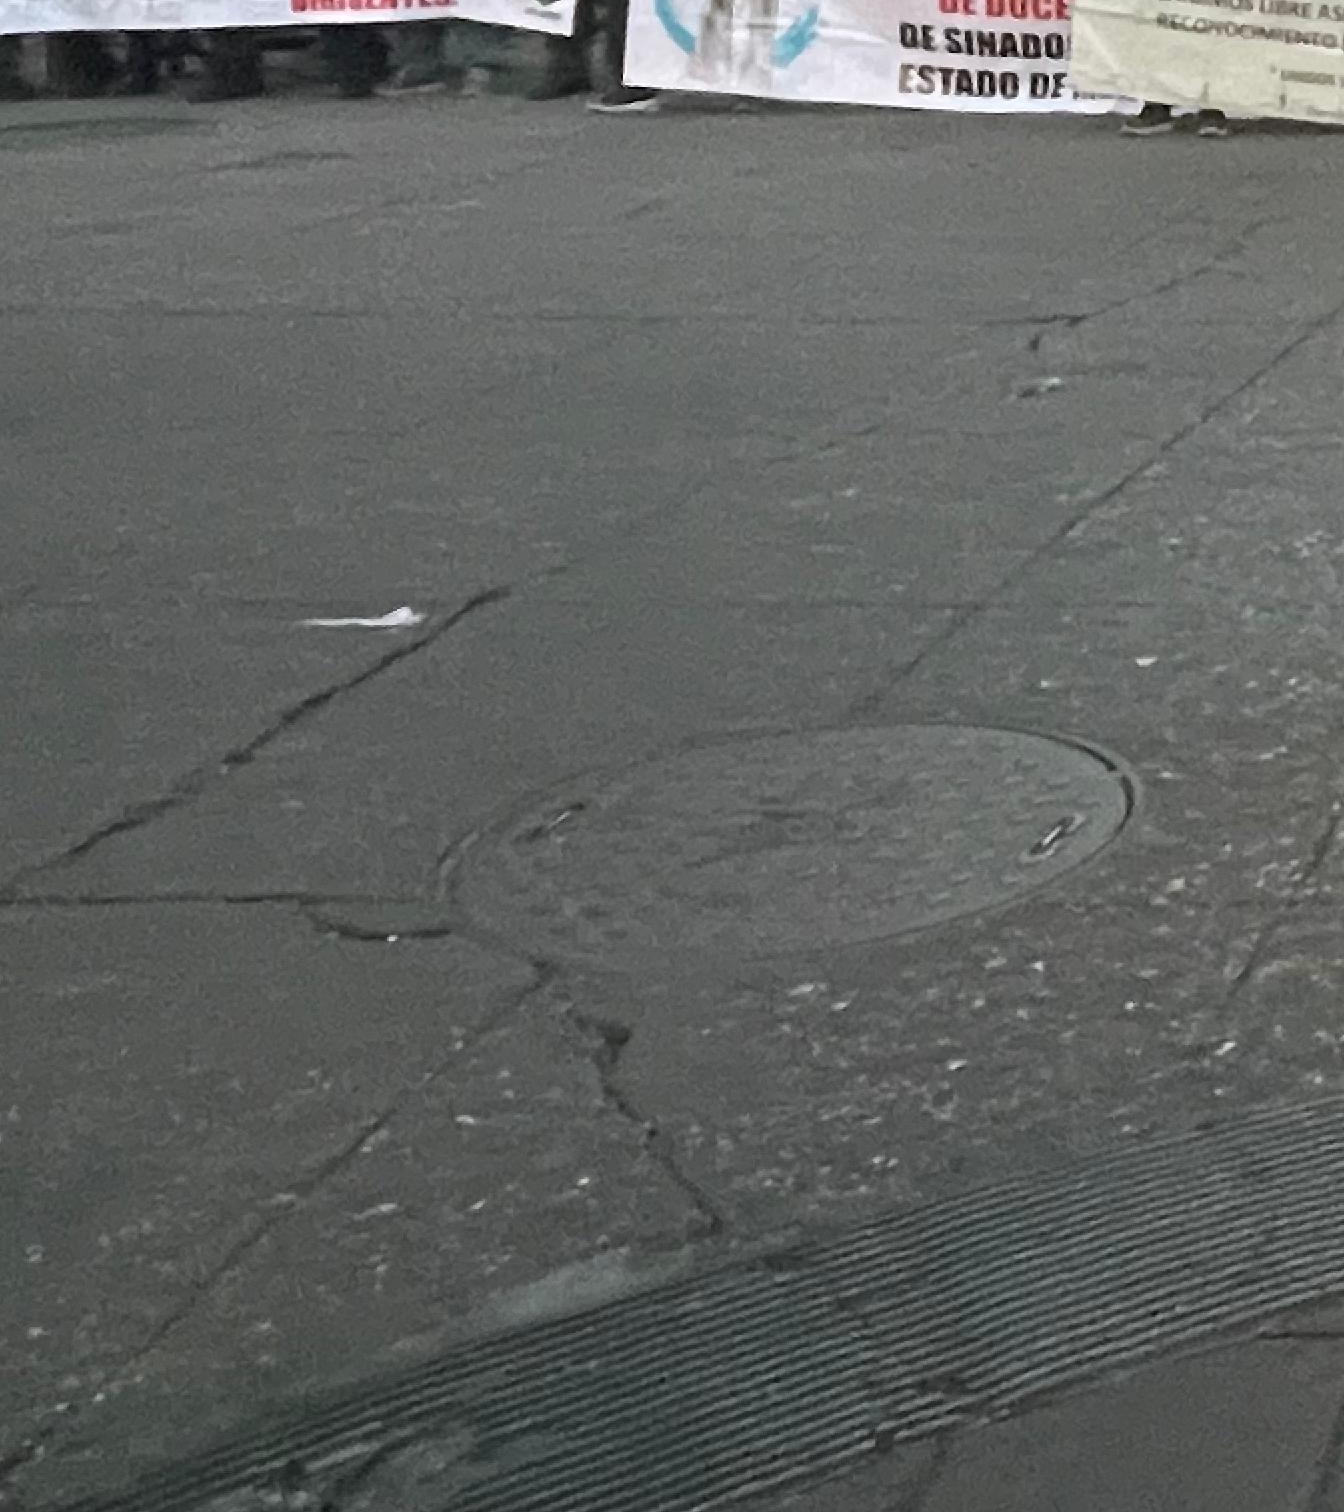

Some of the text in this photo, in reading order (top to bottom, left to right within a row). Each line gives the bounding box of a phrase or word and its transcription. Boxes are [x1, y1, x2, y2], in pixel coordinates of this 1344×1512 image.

[900, 22, 936, 51] DE
[1156, 12, 1338, 49] RECONOCIMIENTO
[899, 63, 1067, 99] ESTADO DE
